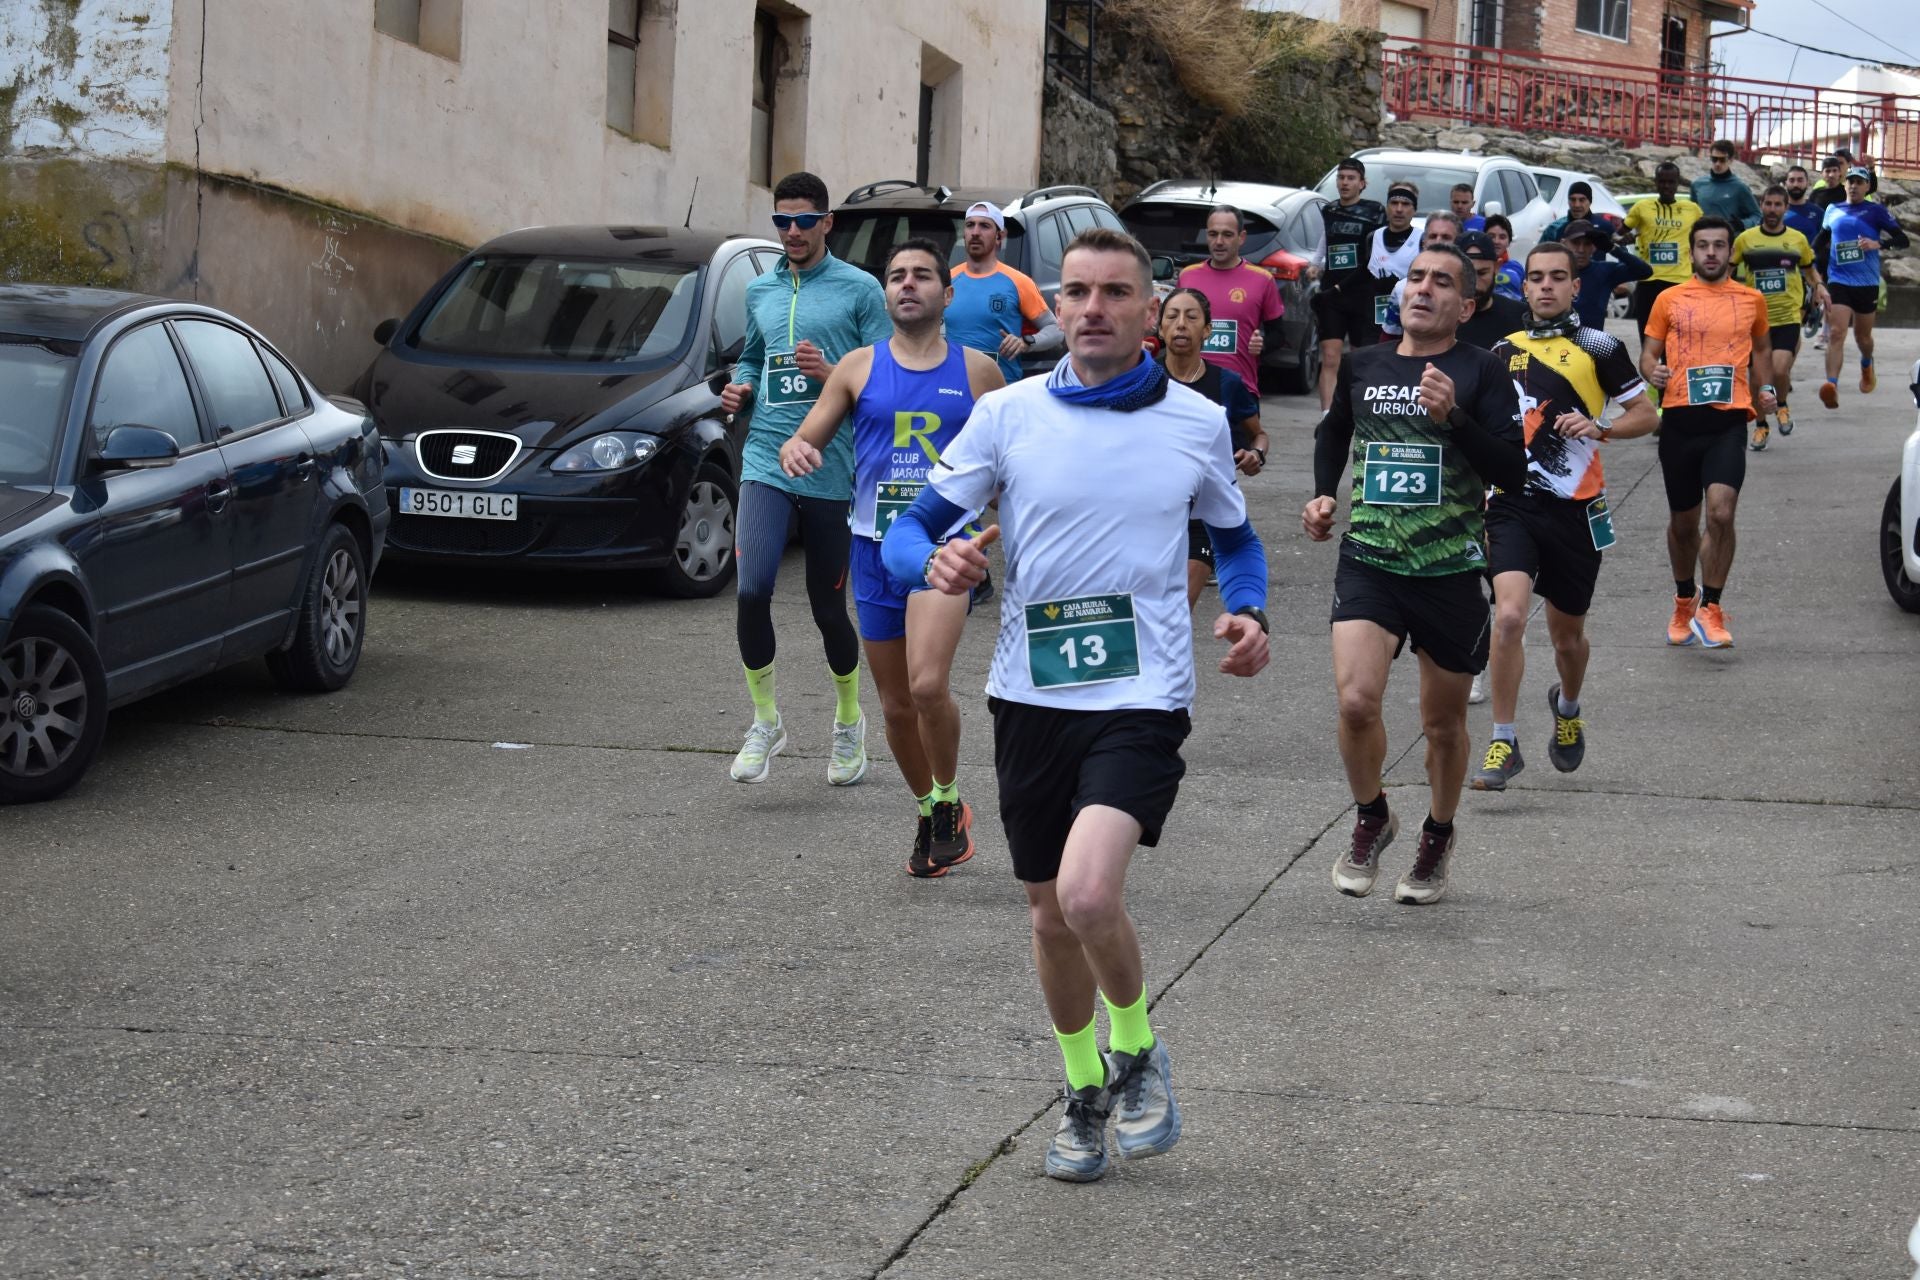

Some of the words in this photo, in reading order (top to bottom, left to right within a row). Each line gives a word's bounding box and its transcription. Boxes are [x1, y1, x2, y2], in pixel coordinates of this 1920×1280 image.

[1334, 255, 1348, 265] 26
[1655, 252, 1674, 261] 106
[1840, 250, 1860, 260] 126
[1760, 280, 1781, 290] 166
[780, 375, 808, 394] 36
[1702, 381, 1723, 397] 37
[1363, 386, 1421, 401] DESAF
[1372, 400, 1427, 416] URBIÓN
[893, 411, 942, 465] R
[891, 453, 920, 464] CLUB
[891, 465, 933, 479] MARATÓ
[1375, 470, 1427, 494] 123
[413, 492, 463, 514] 9501
[473, 496, 513, 517] GLC
[1062, 603, 1080, 611] CAJA
[1082, 600, 1109, 609] RURAL
[1063, 610, 1074, 619] DE
[1075, 606, 1113, 617] NAVARRA
[1059, 634, 1107, 669] 13
